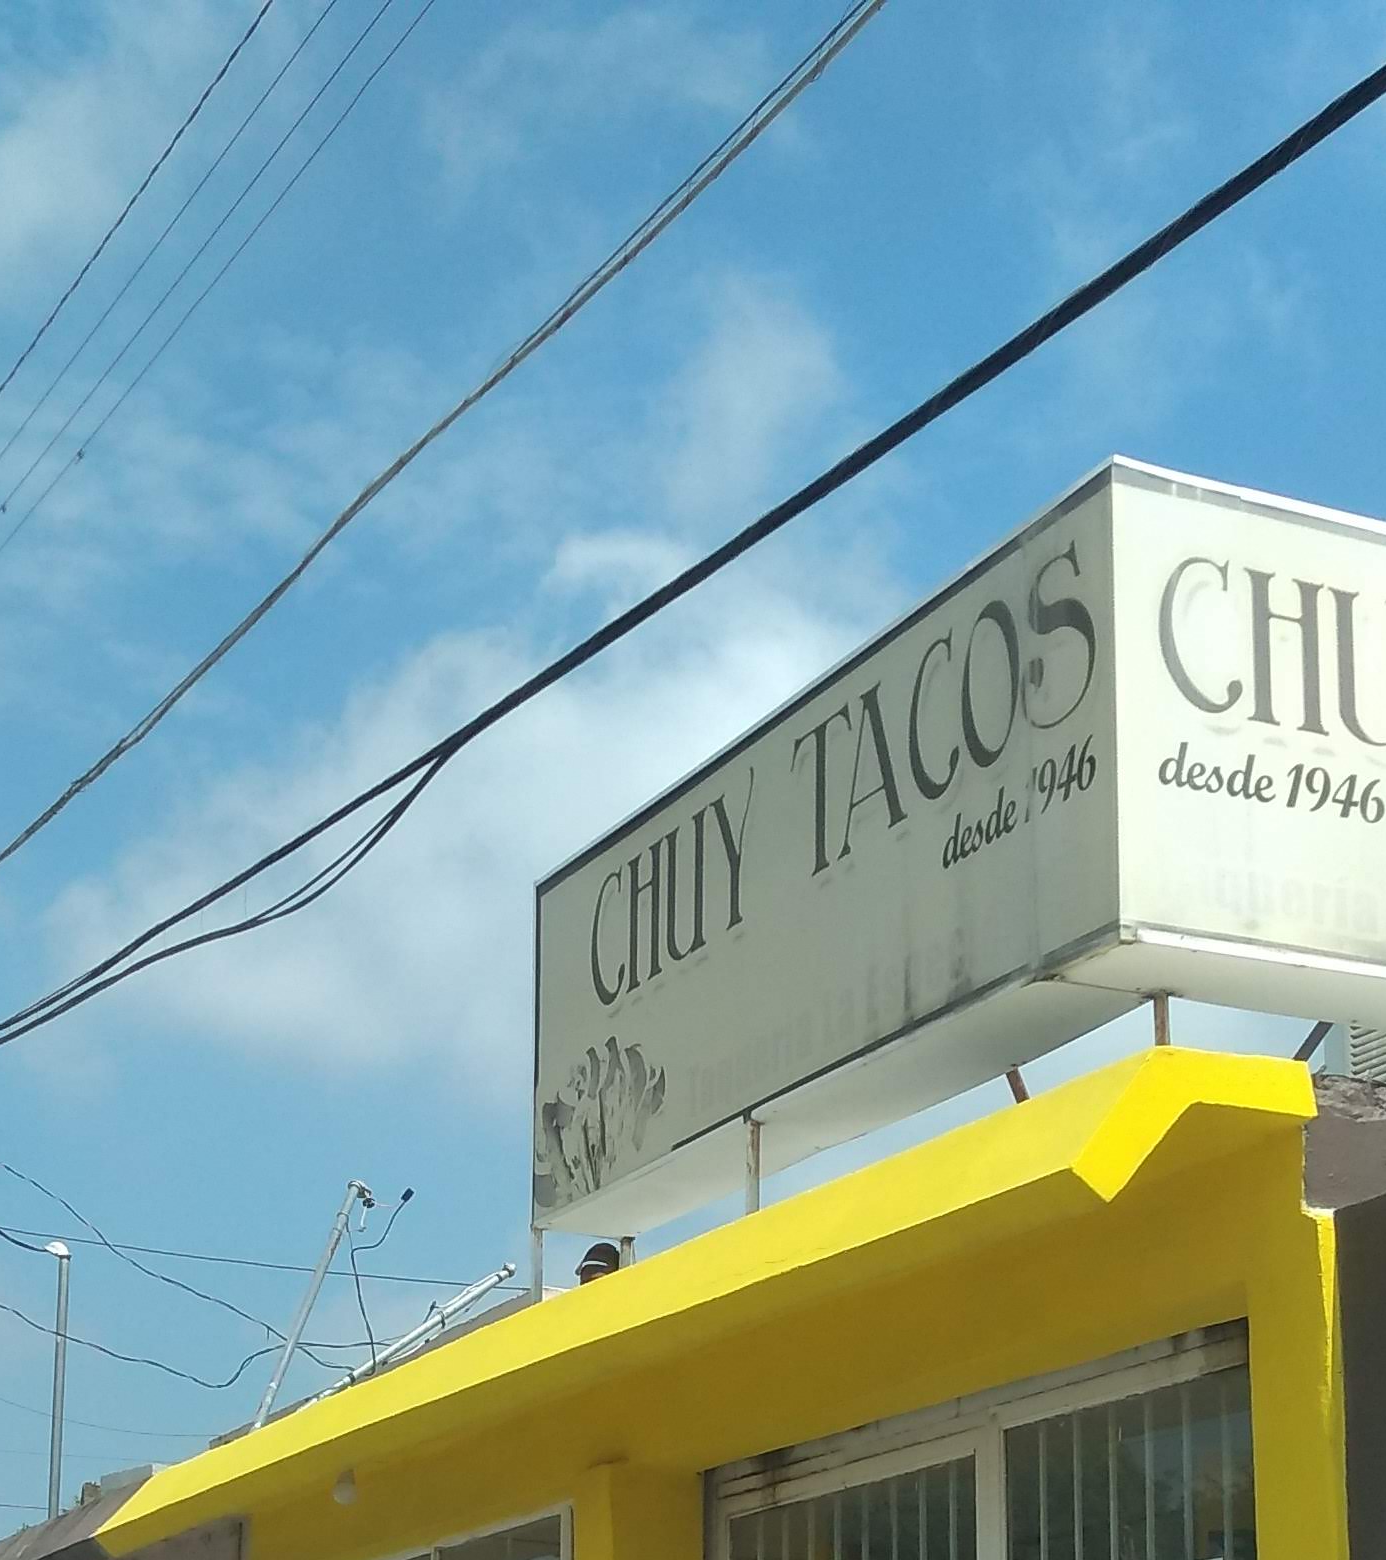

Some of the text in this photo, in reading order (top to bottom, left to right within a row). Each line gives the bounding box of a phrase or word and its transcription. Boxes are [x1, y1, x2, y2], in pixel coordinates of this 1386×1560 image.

[591, 766, 754, 1005] CHUY
[790, 539, 1097, 877] TACOS
[1158, 741, 1385, 823] desde 1946
[942, 785, 1017, 869] desde
